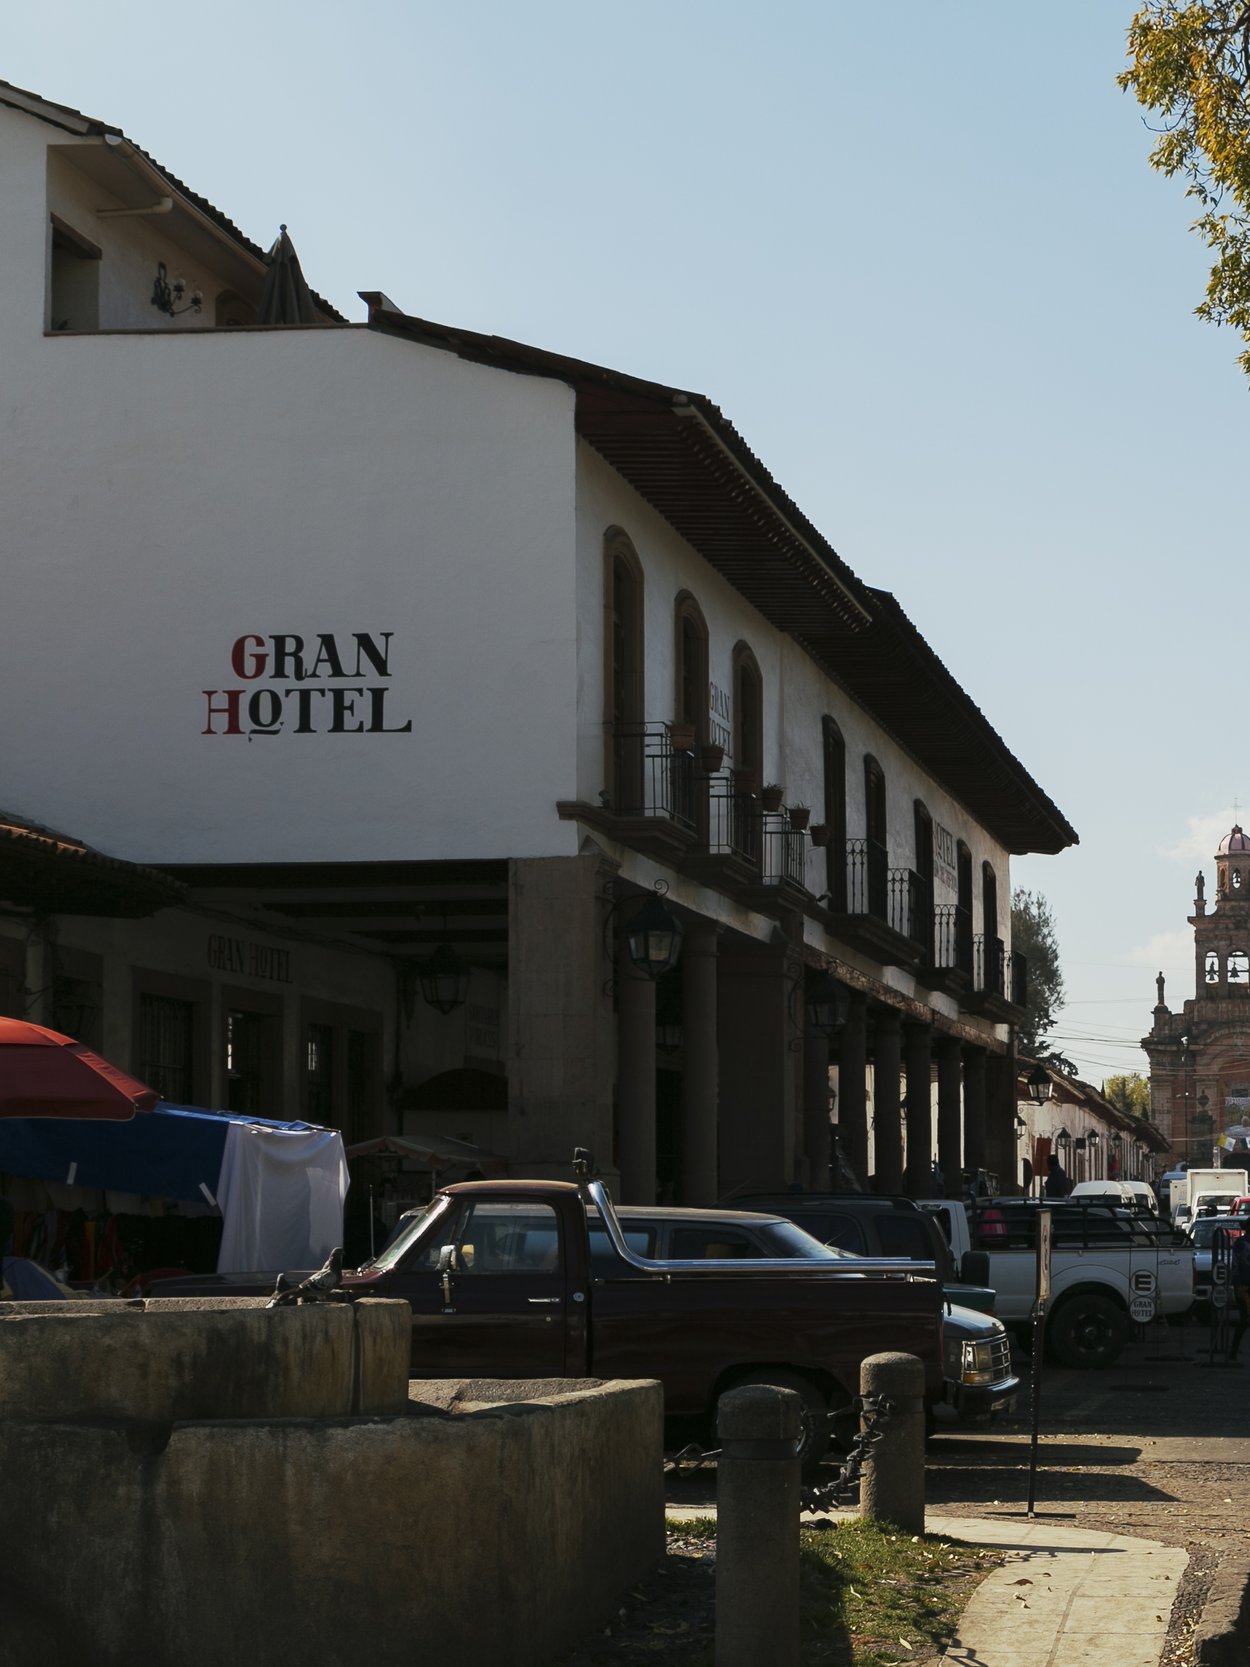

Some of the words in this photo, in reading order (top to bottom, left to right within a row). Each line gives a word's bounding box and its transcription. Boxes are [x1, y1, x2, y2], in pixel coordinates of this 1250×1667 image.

[231, 632, 394, 681] GRAN
[201, 688, 413, 743] HOTEL
[711, 720, 732, 760] OTEL
[208, 934, 244, 975] GRAN
[249, 942, 293, 984] HOTEL
[1135, 1274, 1152, 1291] E
[1216, 1265, 1225, 1280] E
[1132, 1309, 1152, 1317] HOTEL
